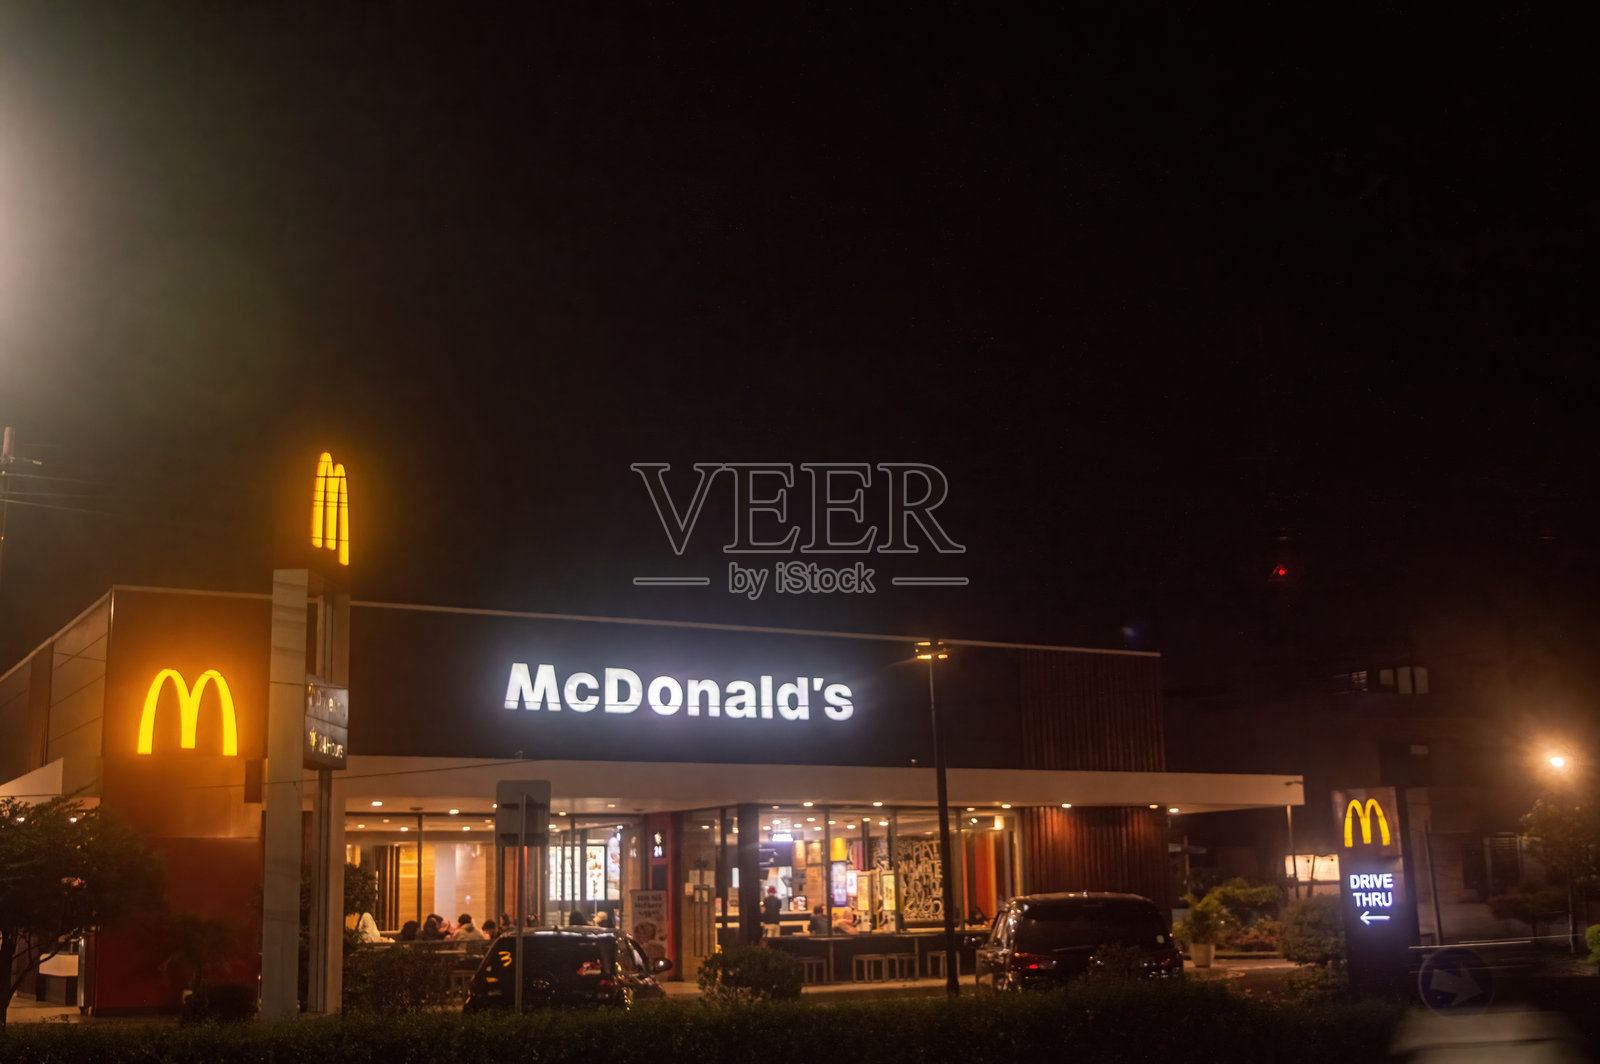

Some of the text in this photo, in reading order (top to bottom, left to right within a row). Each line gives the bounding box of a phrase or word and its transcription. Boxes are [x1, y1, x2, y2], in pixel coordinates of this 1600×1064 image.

[137, 668, 238, 756] M
[504, 661, 854, 721] McDonald's
[1343, 798, 1391, 849] M
[1349, 873, 1394, 890] DRIVE
[1352, 891, 1393, 908] THRU
